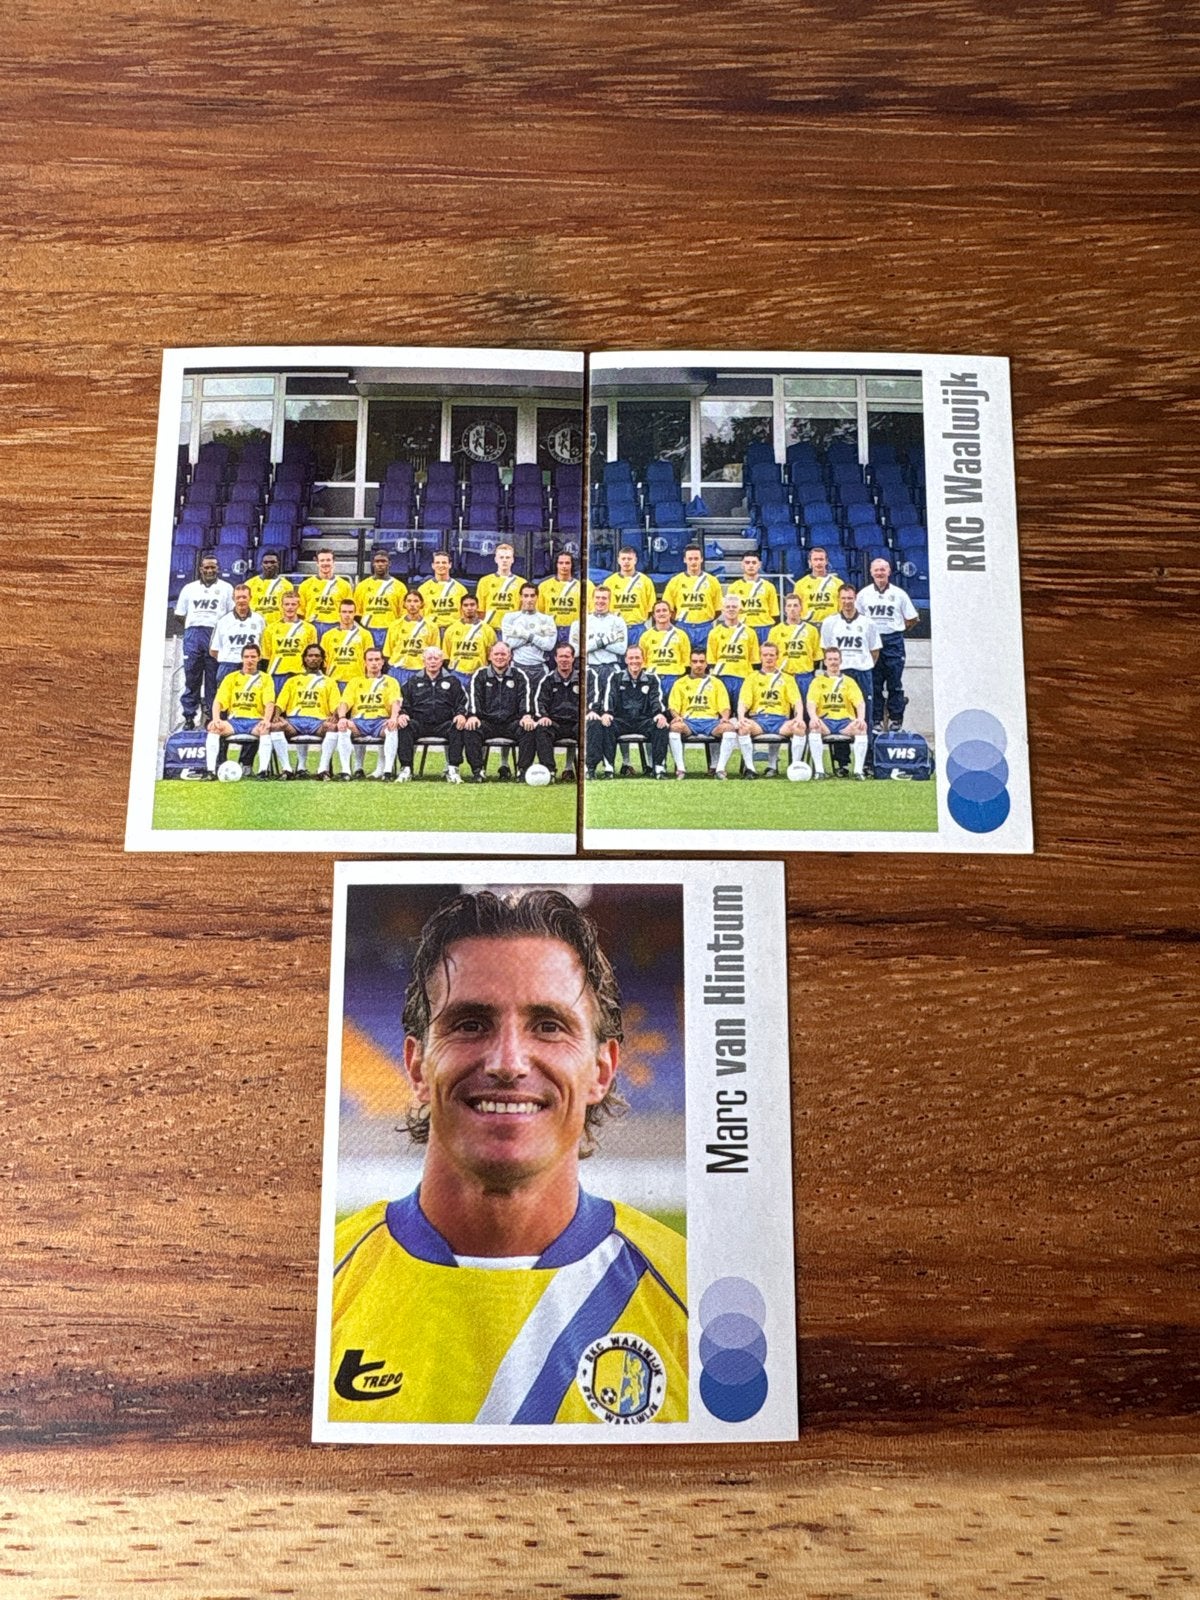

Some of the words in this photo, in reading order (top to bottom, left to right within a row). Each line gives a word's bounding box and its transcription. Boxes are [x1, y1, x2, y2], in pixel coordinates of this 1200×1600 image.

[940, 372, 990, 504] Waalwijk
[945, 516, 986, 572] RKC
[432, 598, 454, 608] VHS
[551, 597, 574, 607] VHS
[614, 593, 637, 604] VHS
[682, 593, 705, 603] VHS
[808, 592, 831, 602] VHS
[193, 599, 219, 610] VHS
[868, 605, 895, 616] VHS
[229, 634, 256, 645] VHS
[836, 636, 863, 648] VHS
[177, 747, 206, 760] VHS
[887, 748, 916, 760] VHS
[703, 885, 745, 1005] Hintum
[715, 1018, 747, 1077] van
[705, 1090, 749, 1173] Marc
[584, 1342, 605, 1363] RKC
[610, 1336, 663, 1377] WAALWIJK
[362, 1371, 404, 1388] TREPO
